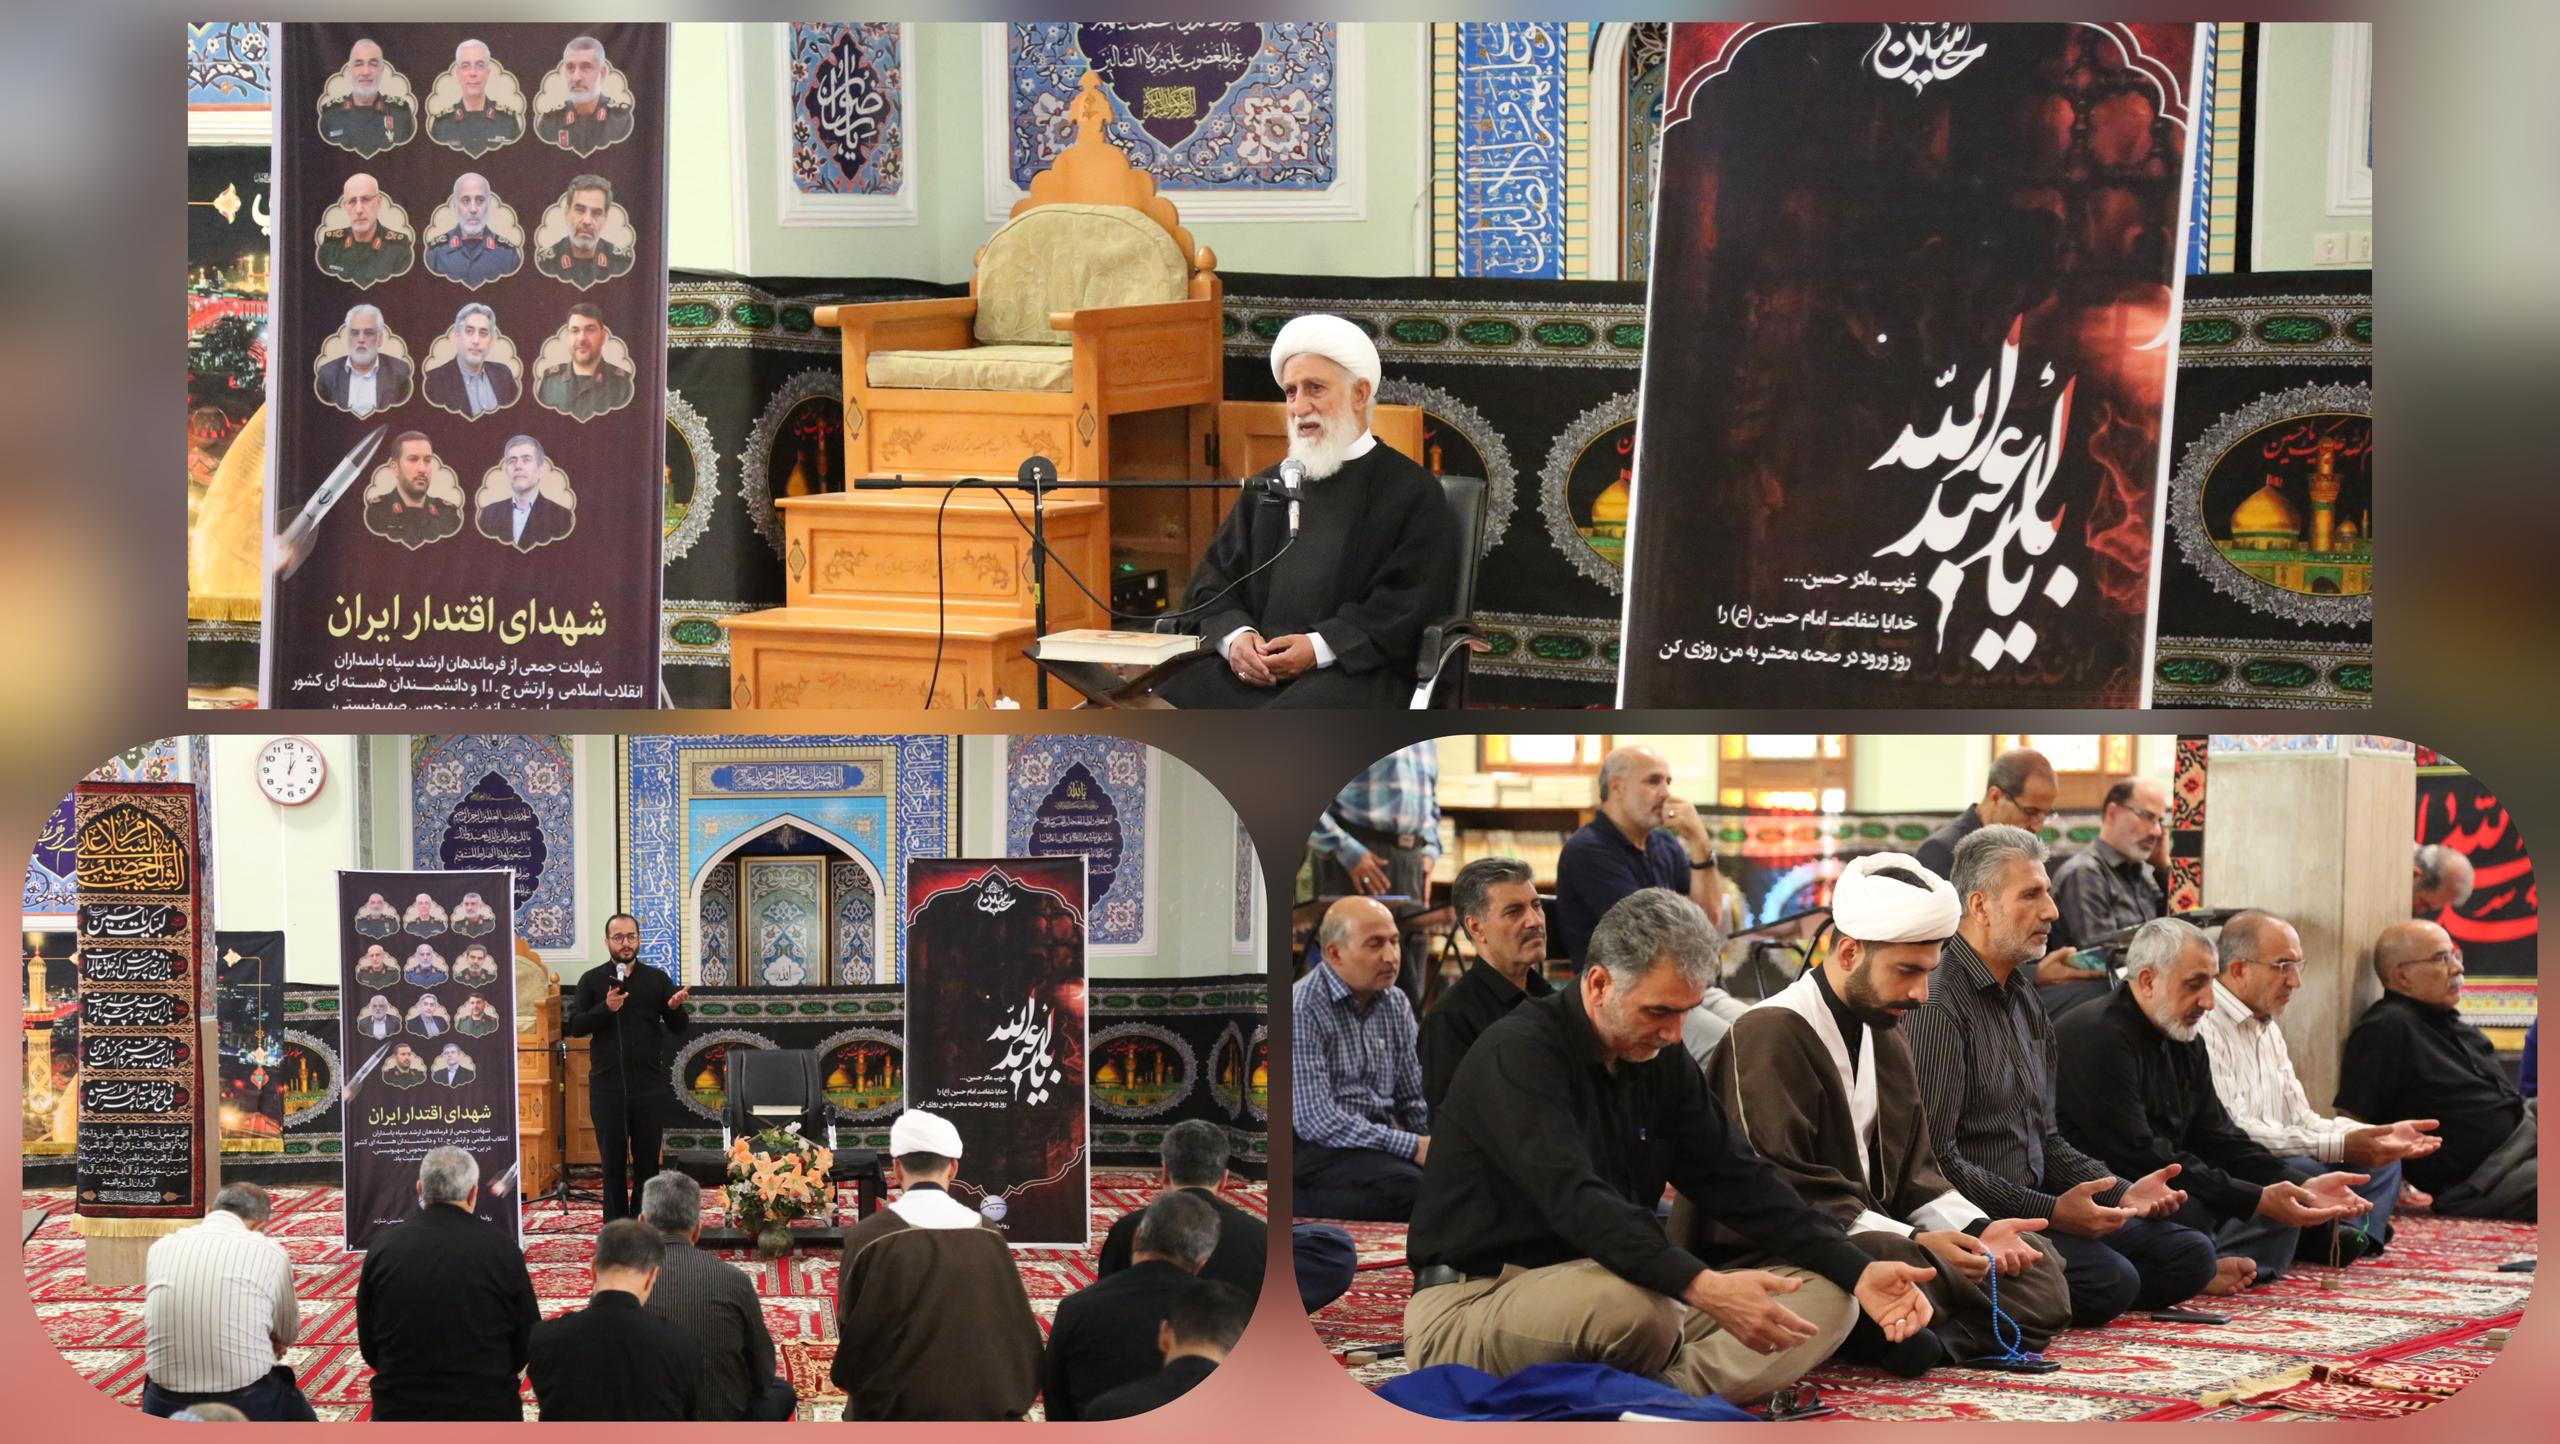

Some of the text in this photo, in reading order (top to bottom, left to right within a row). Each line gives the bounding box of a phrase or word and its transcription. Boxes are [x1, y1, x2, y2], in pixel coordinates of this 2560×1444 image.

[1850, 570, 1876, 588] مادر
[1880, 572, 1916, 594] غریب
[328, 593, 607, 646] شهدای اقتدار ایران
[1717, 604, 1917, 632] خدایا شفاعت امام حسین (ع) را
[1659, 639, 1911, 671] روز ورود در صحنه محشر به من روزی کن
[335, 652, 602, 678] شهادت جمعی از فرماندهان ارشد سپاه پاسداران
[291, 673, 323, 691] کشور
[325, 674, 339, 691] ای
[342, 676, 387, 688] هسته
[389, 675, 468, 693] دانشمندان
[470, 684, 477, 696] و
[513, 680, 545, 699] ارتش
[548, 687, 553, 699] و
[559, 683, 601, 700] اسلامی
[604, 684, 643, 700] انقلاب
[368, 1105, 492, 1126] شهدای اقتدار ایران
